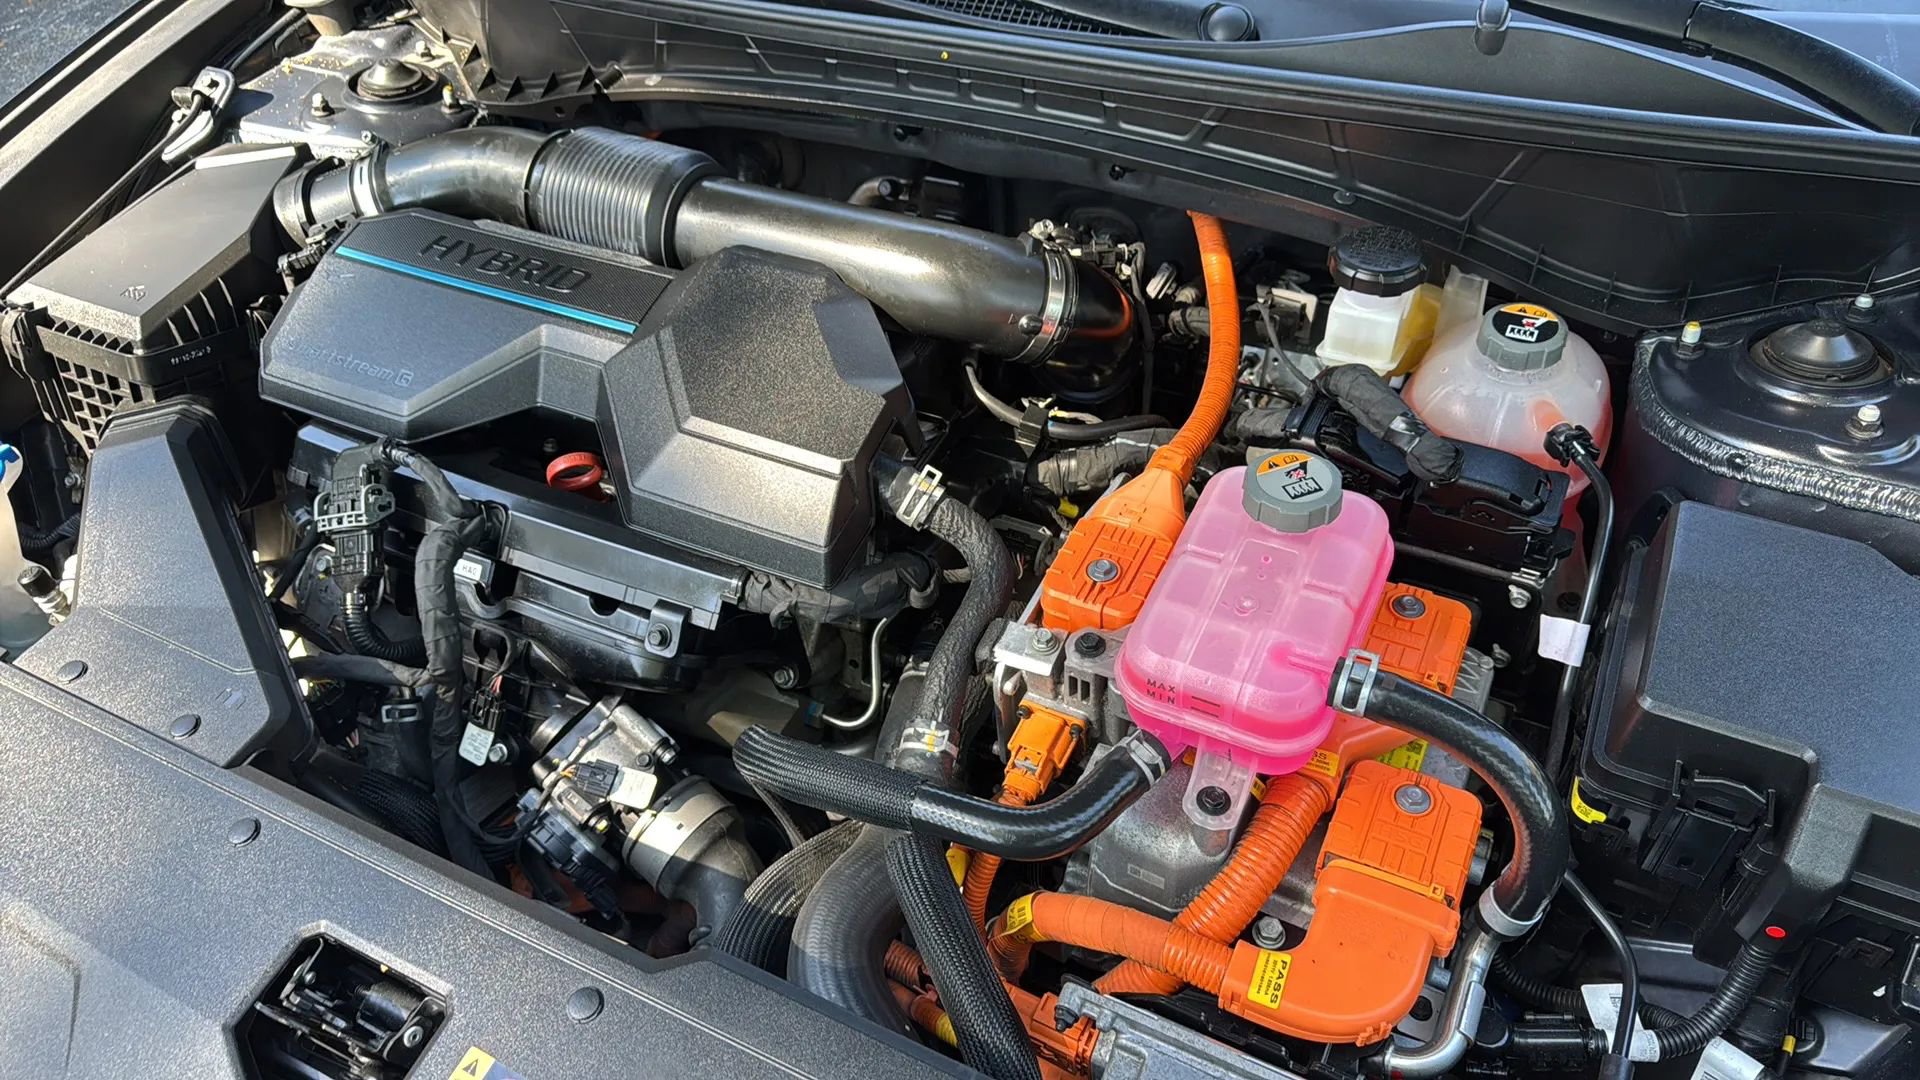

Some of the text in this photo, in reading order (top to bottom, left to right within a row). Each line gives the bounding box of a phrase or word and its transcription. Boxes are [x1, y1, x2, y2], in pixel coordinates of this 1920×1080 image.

[417, 235, 592, 293] HYBRID
[1147, 678, 1176, 694] MAX
[1147, 689, 1176, 704] MIN
[1269, 959, 1288, 1004] PASS
